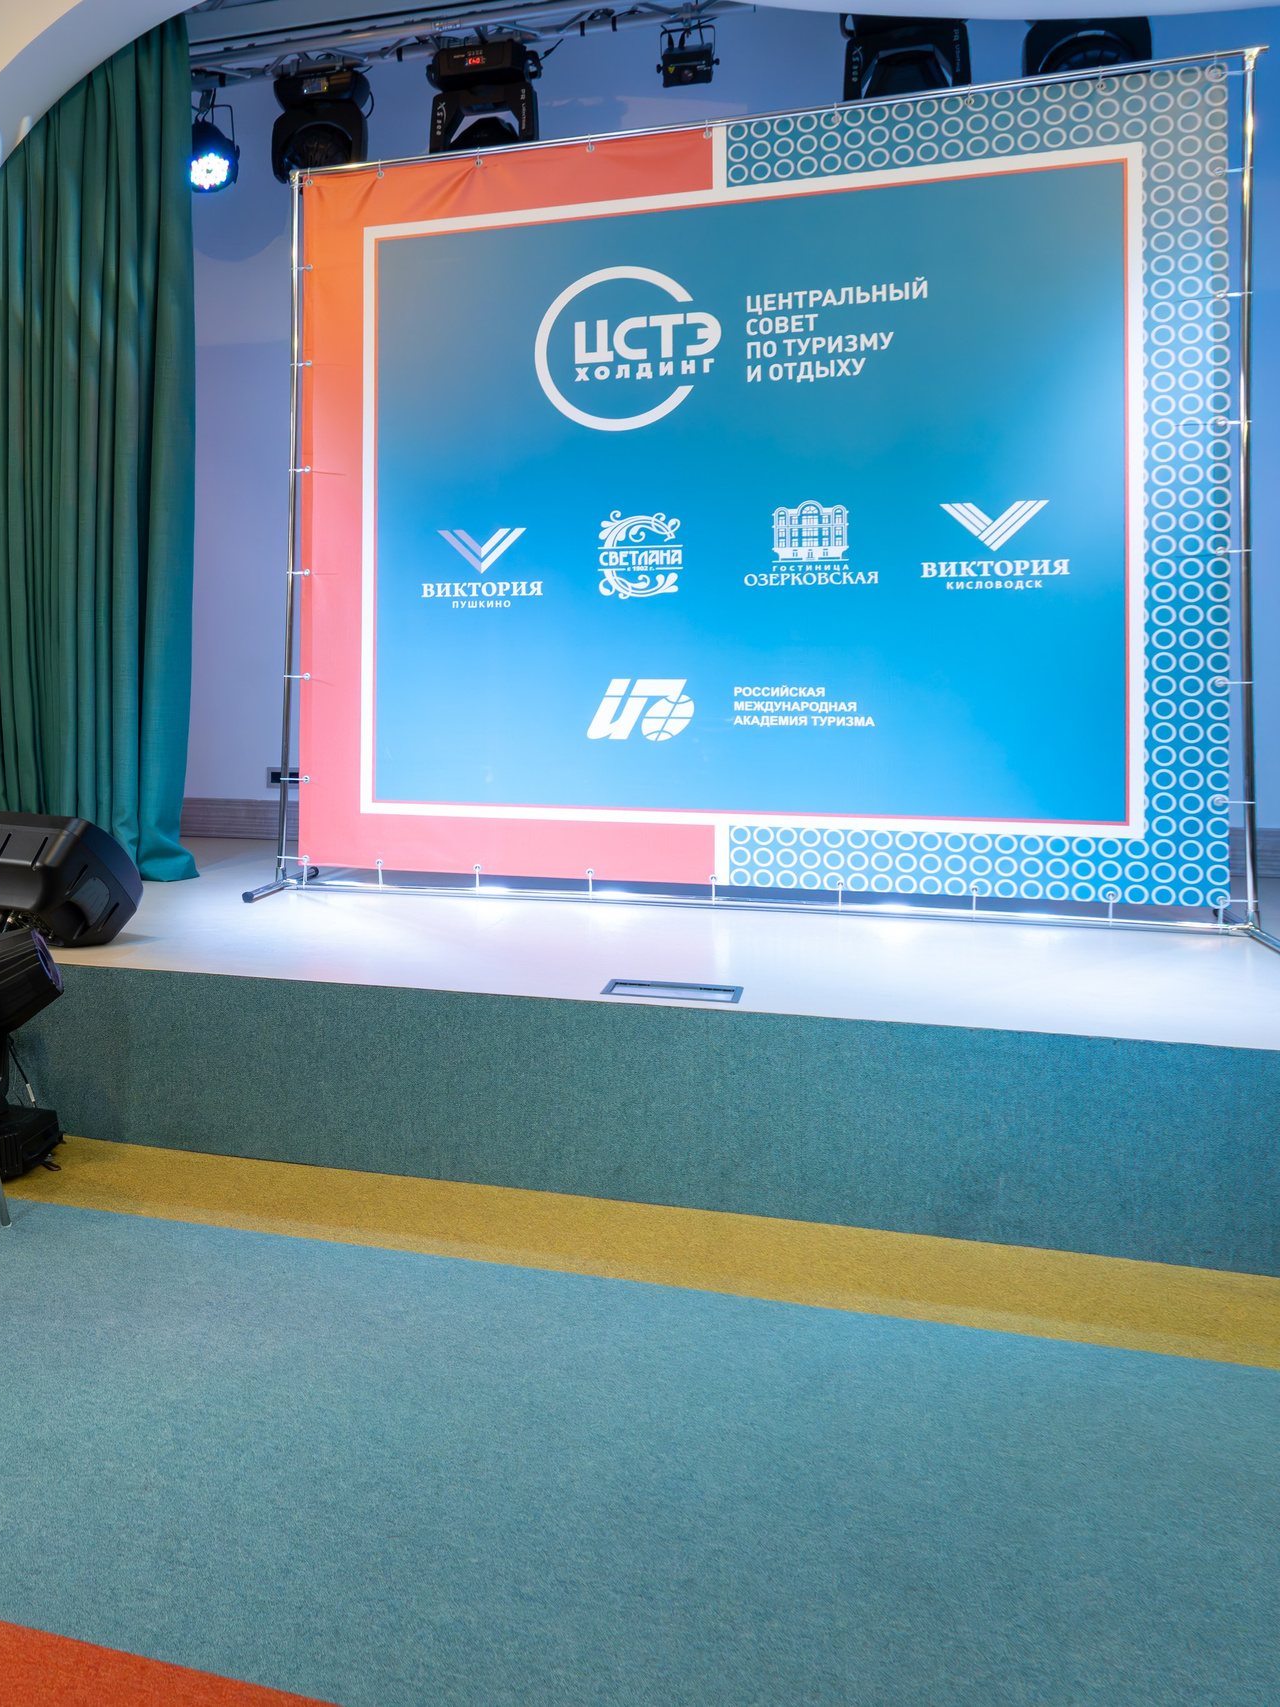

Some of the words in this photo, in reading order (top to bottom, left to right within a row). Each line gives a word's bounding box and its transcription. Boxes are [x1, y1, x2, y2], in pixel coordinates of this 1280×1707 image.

[746, 276, 928, 314] ЦЕНТРАЛЬНЫЙ
[746, 313, 819, 336] СОВЕТ
[574, 311, 722, 365] ЦСТЭ
[746, 340, 778, 360] ПО
[783, 331, 894, 357] ТУРИЗМУ
[574, 357, 715, 382] ХОЛДИНГ
[746, 364, 762, 383] И
[768, 357, 867, 383] ОТДЫХУ
[599, 550, 683, 566] СВЕТЛАНА
[772, 564, 850, 572] ГОСТИНИЦА
[920, 558, 1071, 579] ВИКТОРИЯ
[743, 571, 879, 587] ОЗЕРКОВСКАЯ
[946, 579, 1043, 590] КИСЛОВОДСК
[421, 580, 544, 598] ВИКТОРИЯ
[452, 600, 511, 609] ПУШКИНО
[733, 684, 826, 698] РОССИЙСКАЯ
[733, 700, 858, 713] МЕЖДУНАРОДНАЯ
[733, 715, 808, 728] АКАДЕМИЯ
[811, 715, 876, 728] ТУРИЗМА
